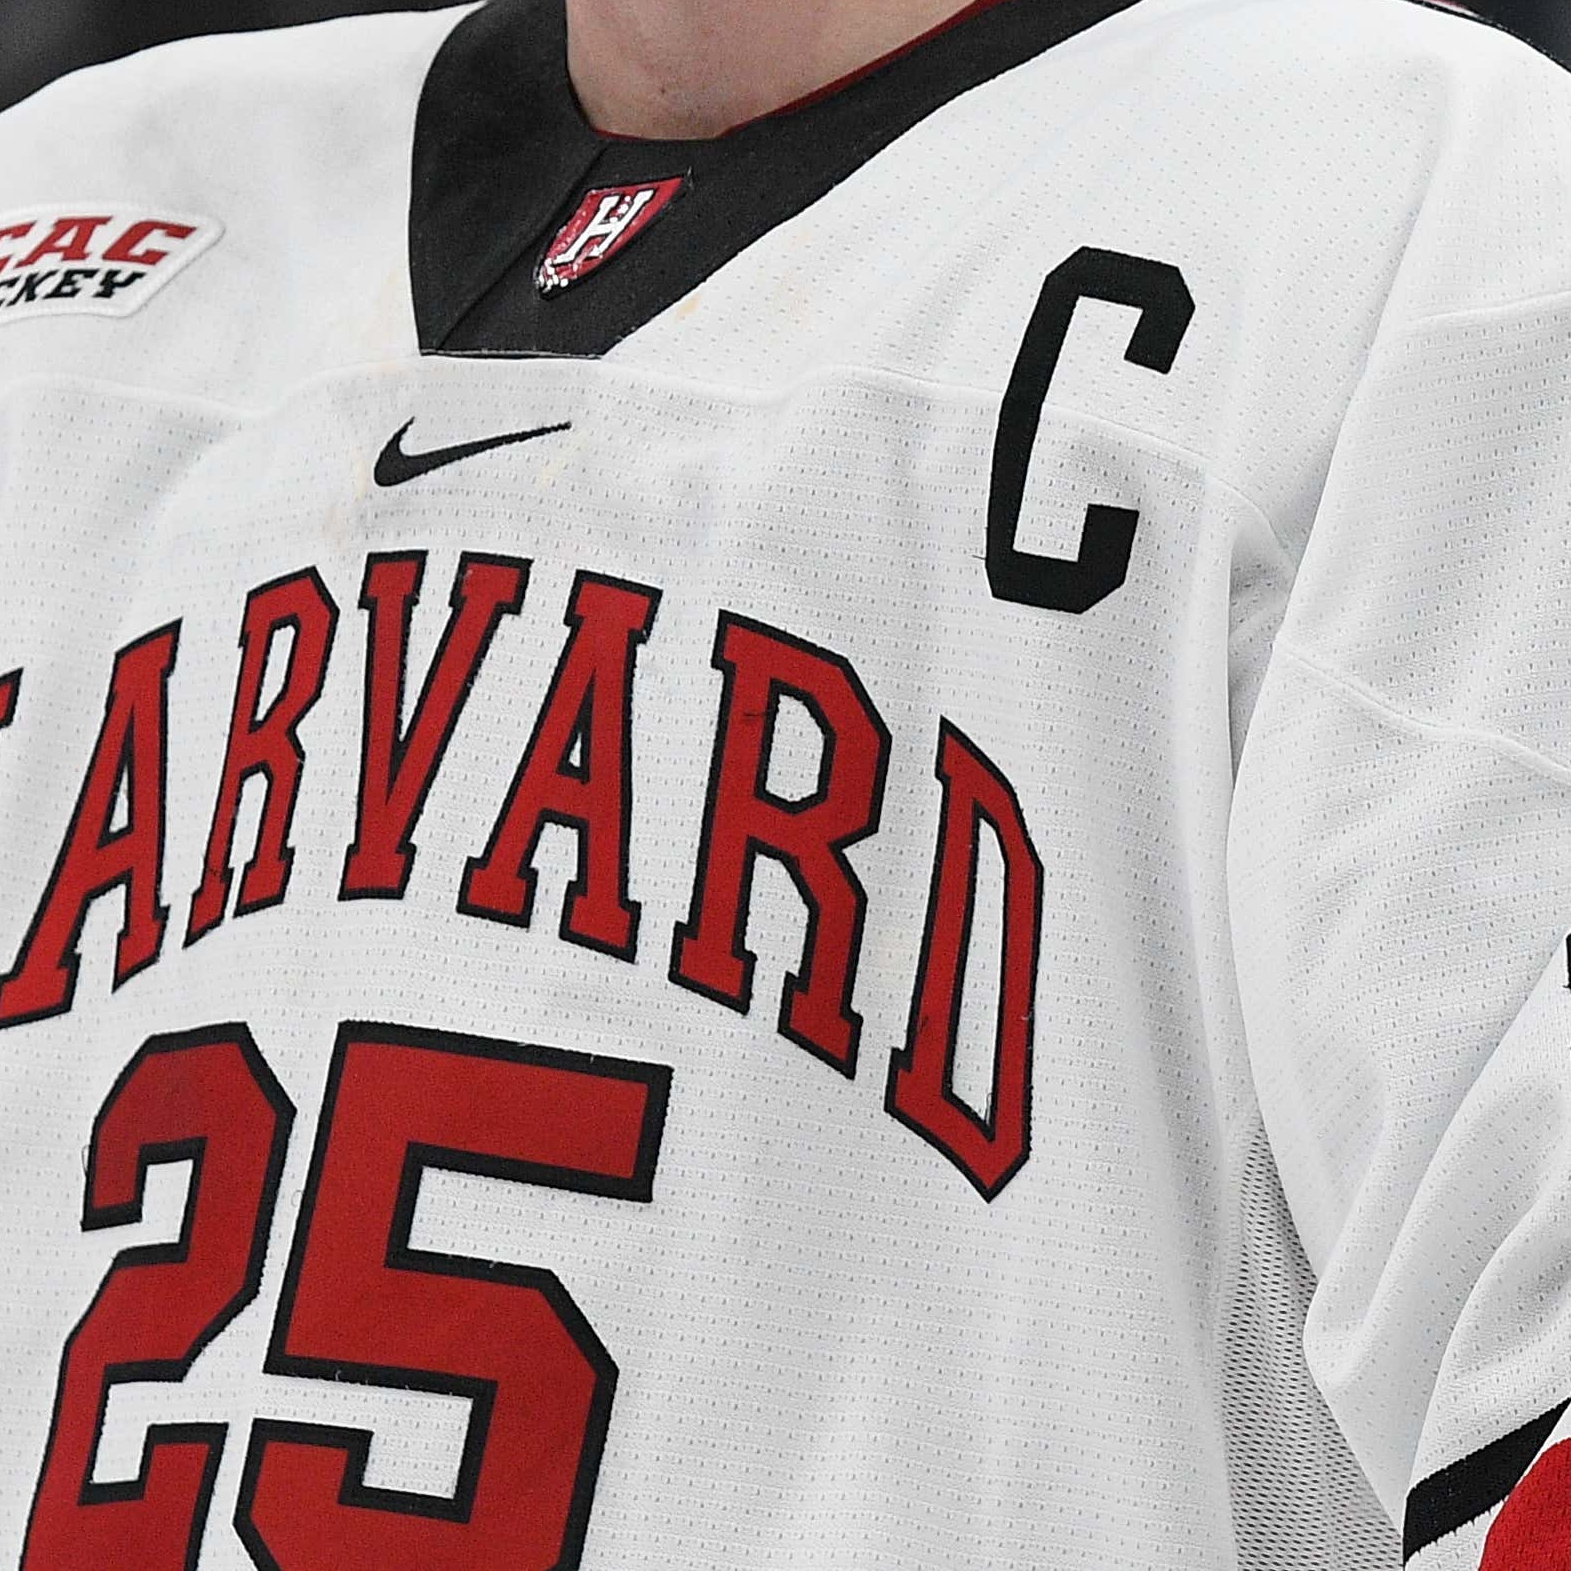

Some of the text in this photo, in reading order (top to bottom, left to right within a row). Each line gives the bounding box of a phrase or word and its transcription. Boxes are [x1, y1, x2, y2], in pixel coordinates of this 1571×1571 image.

[552, 188, 655, 265] H
[985, 245, 1196, 615] C
[17, 1020, 675, 1571] 25
